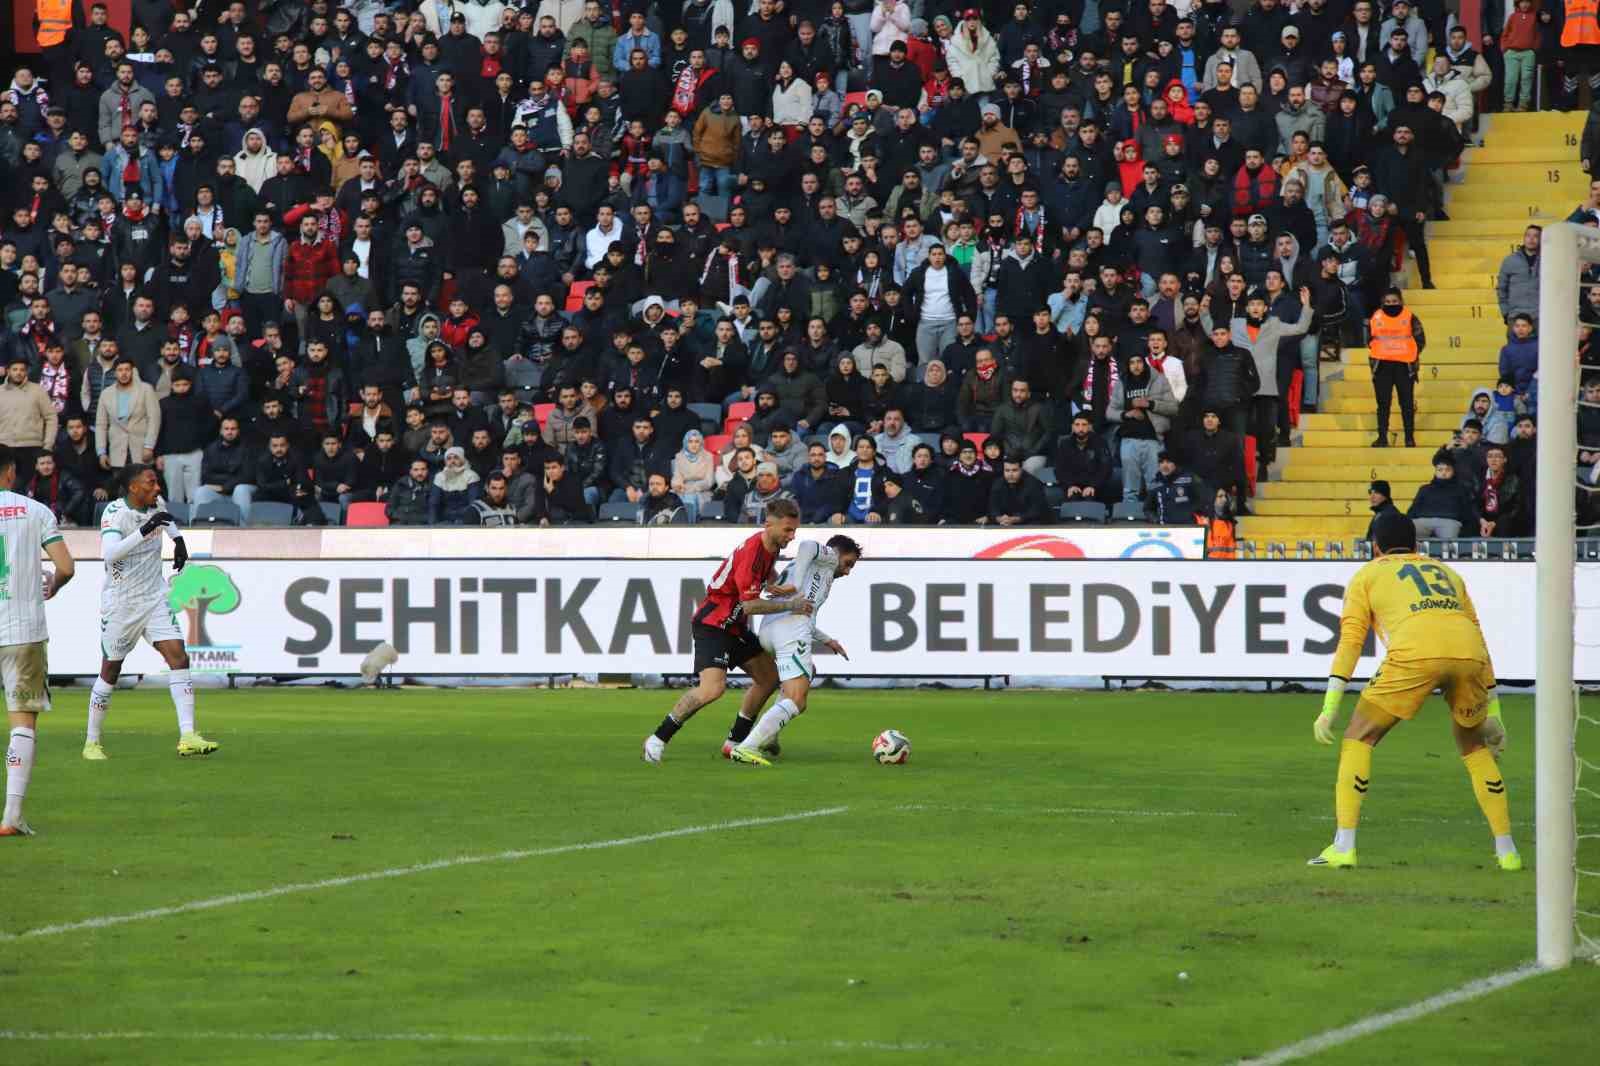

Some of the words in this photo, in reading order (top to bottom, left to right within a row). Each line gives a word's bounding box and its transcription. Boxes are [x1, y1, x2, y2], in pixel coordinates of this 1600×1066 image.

[1564, 134, 1577, 146] 16
[1547, 170, 1560, 183] 15
[1472, 306, 1482, 319] 11
[1449, 336, 1461, 348] 10
[1432, 367, 1439, 378] 9
[1370, 469, 1377, 481] 6
[855, 477, 872, 509] 9
[0, 506, 27, 518] ER
[1345, 503, 1352, 515] 5
[1397, 563, 1457, 597] 13
